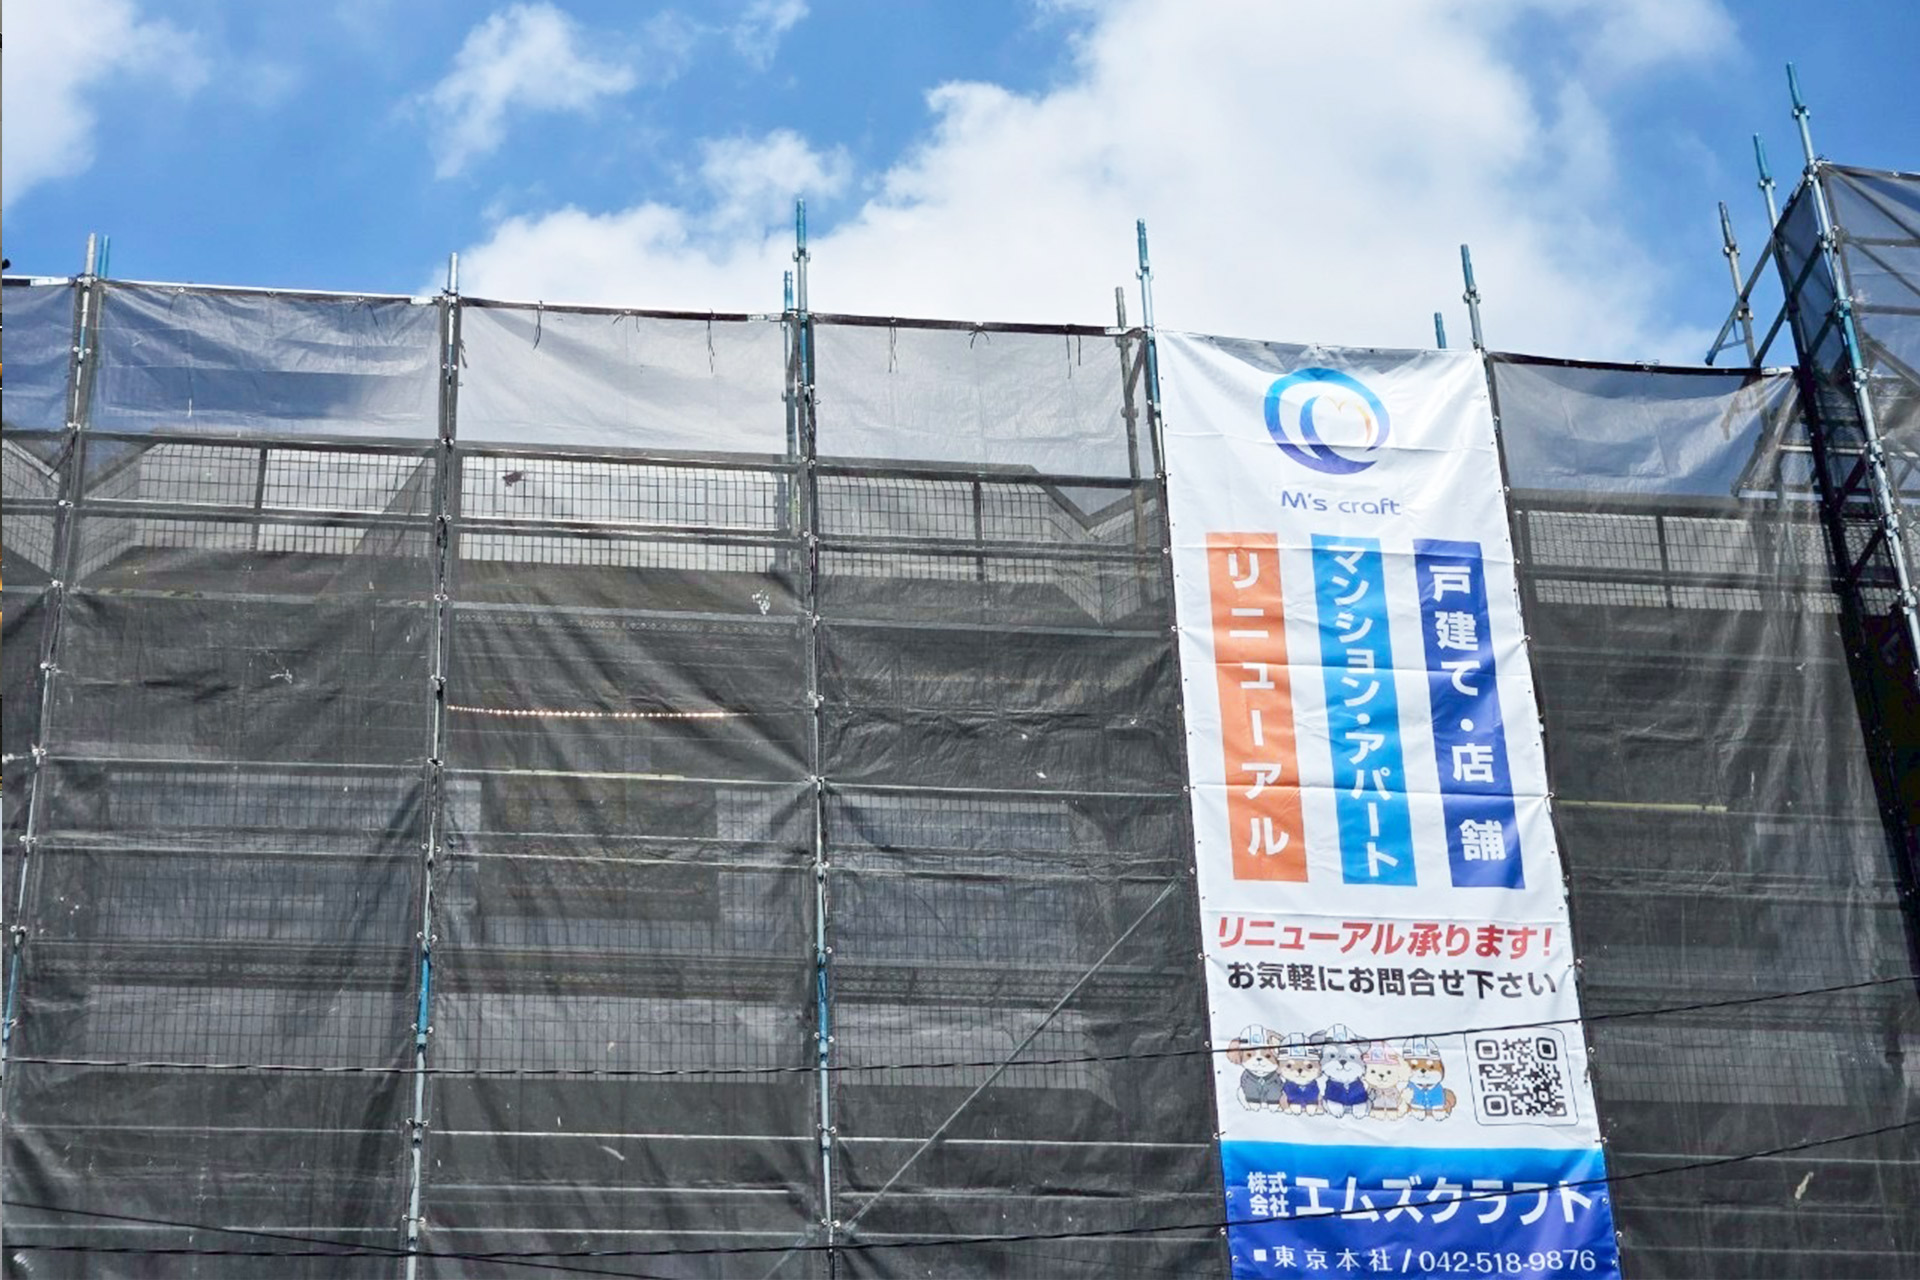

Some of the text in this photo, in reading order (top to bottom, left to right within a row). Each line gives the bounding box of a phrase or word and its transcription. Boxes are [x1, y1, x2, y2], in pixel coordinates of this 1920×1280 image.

[1281, 490, 1401, 516] M's craft
[1228, 552, 1290, 856] リニューアル
[1327, 544, 1399, 877] マンション・アパート
[1429, 565, 1507, 861] 戸建て・店舗
[1226, 961, 1557, 999] お気軽にお問合せ下さい
[1295, 1175, 1593, 1226] エムズクラフト
